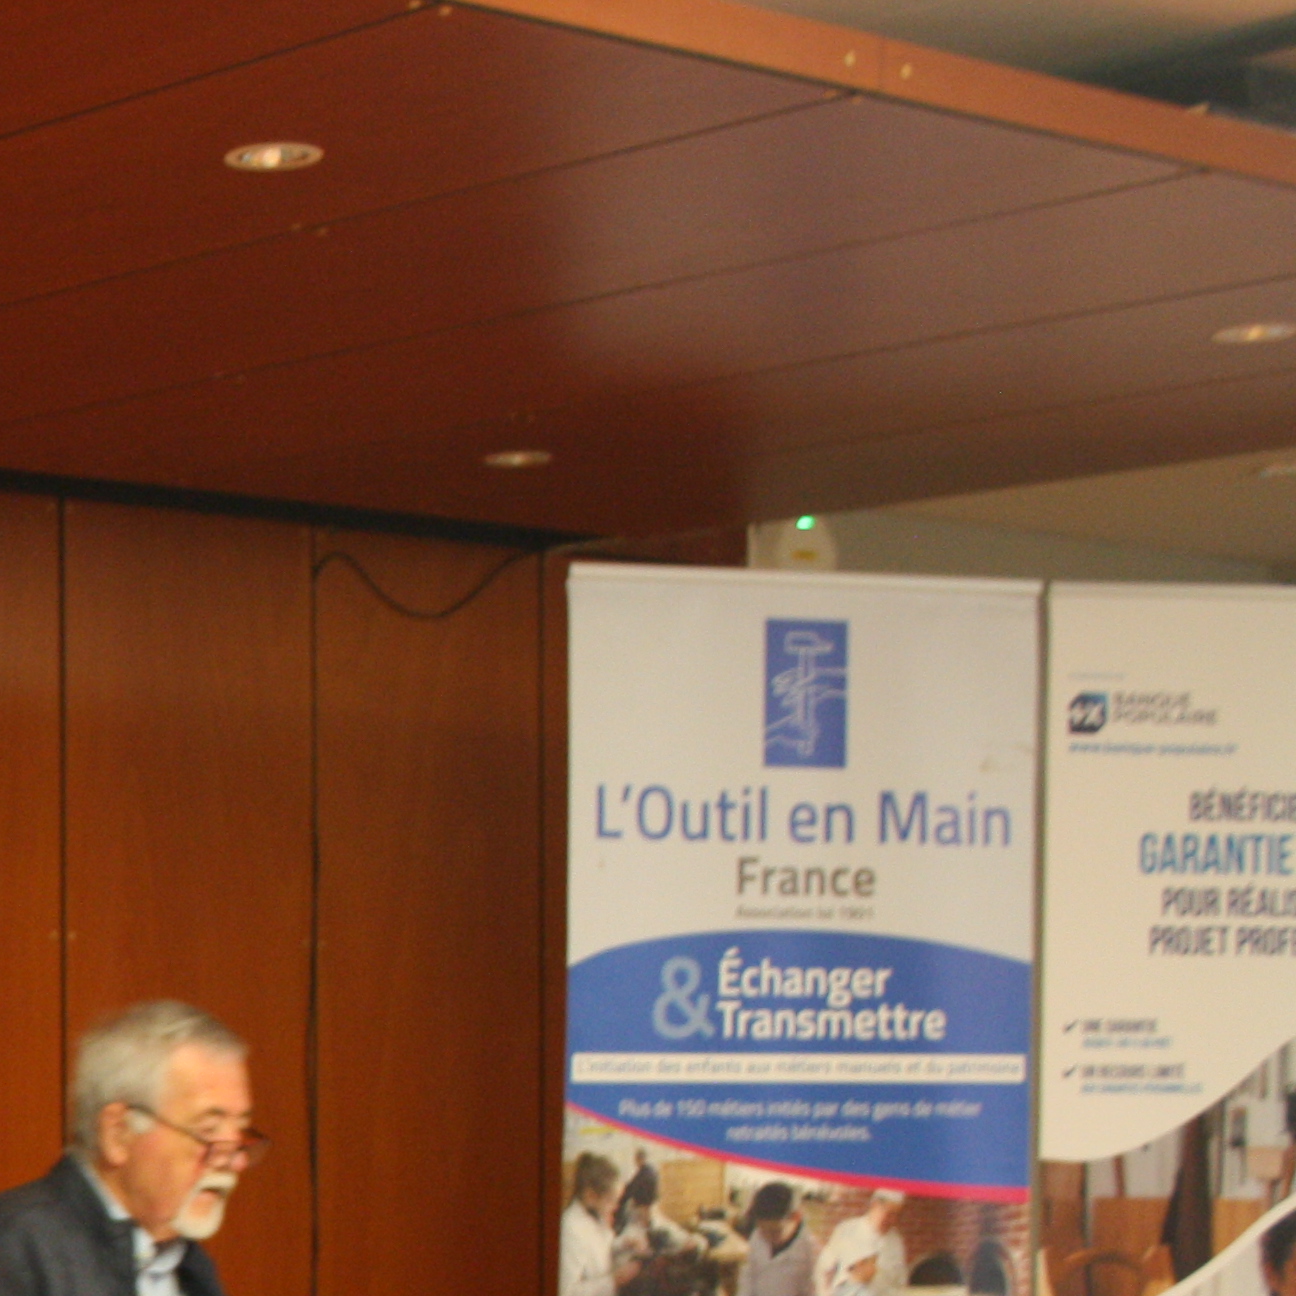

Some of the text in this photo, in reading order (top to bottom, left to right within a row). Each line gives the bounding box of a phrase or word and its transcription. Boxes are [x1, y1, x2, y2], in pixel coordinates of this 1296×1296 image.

[595, 784, 1012, 848] L'Outil en Main
[736, 856, 877, 898] France
[1149, 924, 1229, 956] PROJET
[653, 956, 714, 1039] &
[718, 947, 893, 1008] Échanger
[715, 999, 948, 1041] Transmettre
